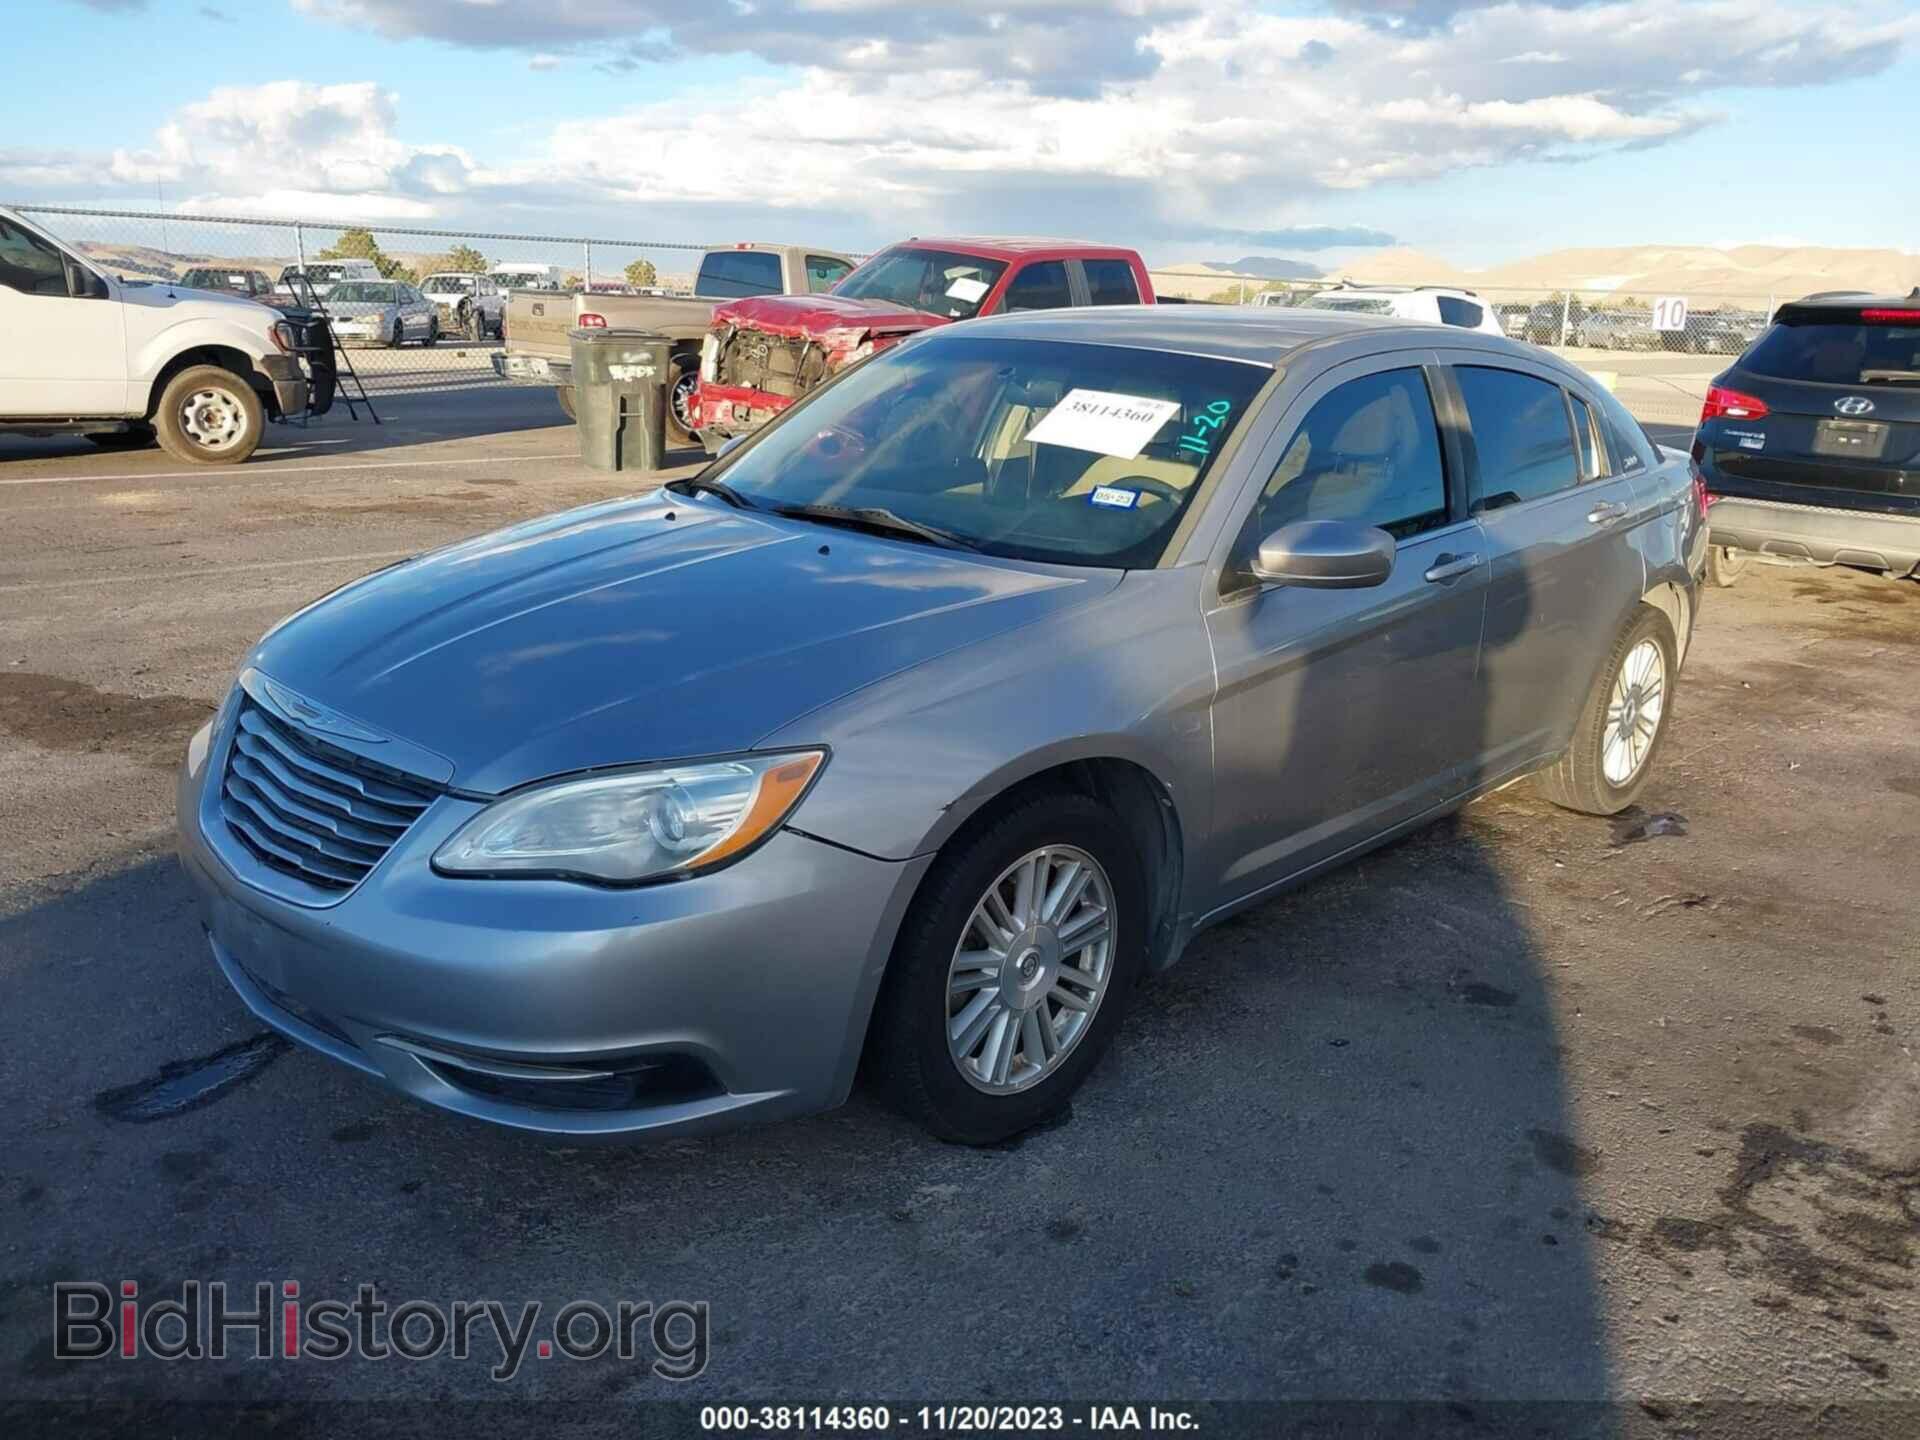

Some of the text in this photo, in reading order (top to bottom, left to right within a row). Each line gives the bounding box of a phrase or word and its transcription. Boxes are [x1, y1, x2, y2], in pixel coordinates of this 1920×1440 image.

[1657, 300, 1684, 327] 10
[1066, 401, 1154, 423] 38114360
[1179, 400, 1230, 454] 11-20
